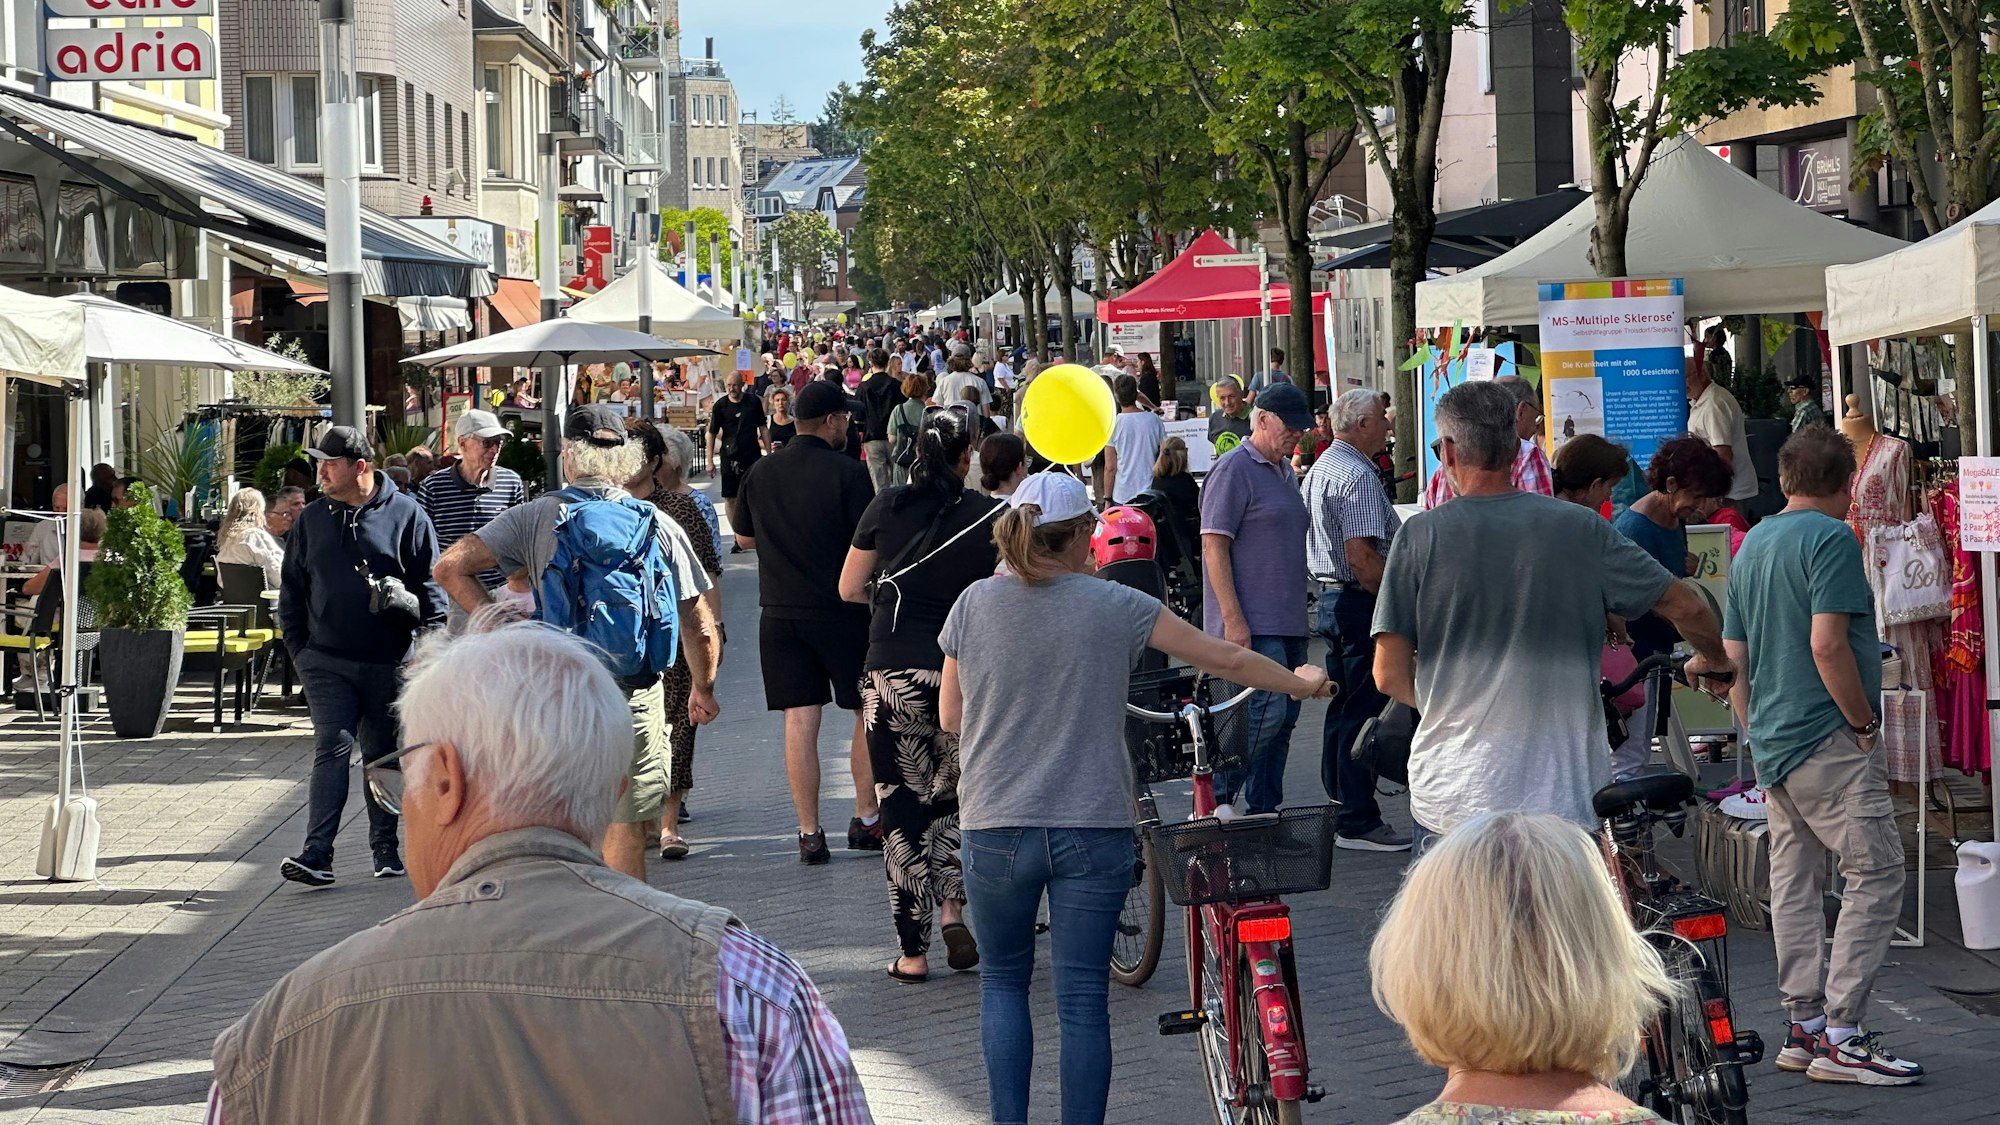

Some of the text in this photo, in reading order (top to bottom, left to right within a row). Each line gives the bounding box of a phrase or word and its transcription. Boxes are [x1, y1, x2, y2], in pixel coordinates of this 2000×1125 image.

[57, 31, 201, 74] adria
[1572, 328, 1622, 337] Selbsthilfegruppe
[1562, 361, 1574, 369] Die
[1575, 360, 1609, 368] Krankheit
[1622, 368, 1680, 377] 1000 Gesichtern
[1963, 468, 2000, 478] MegaSALE
[1119, 516, 1141, 524] uvex
